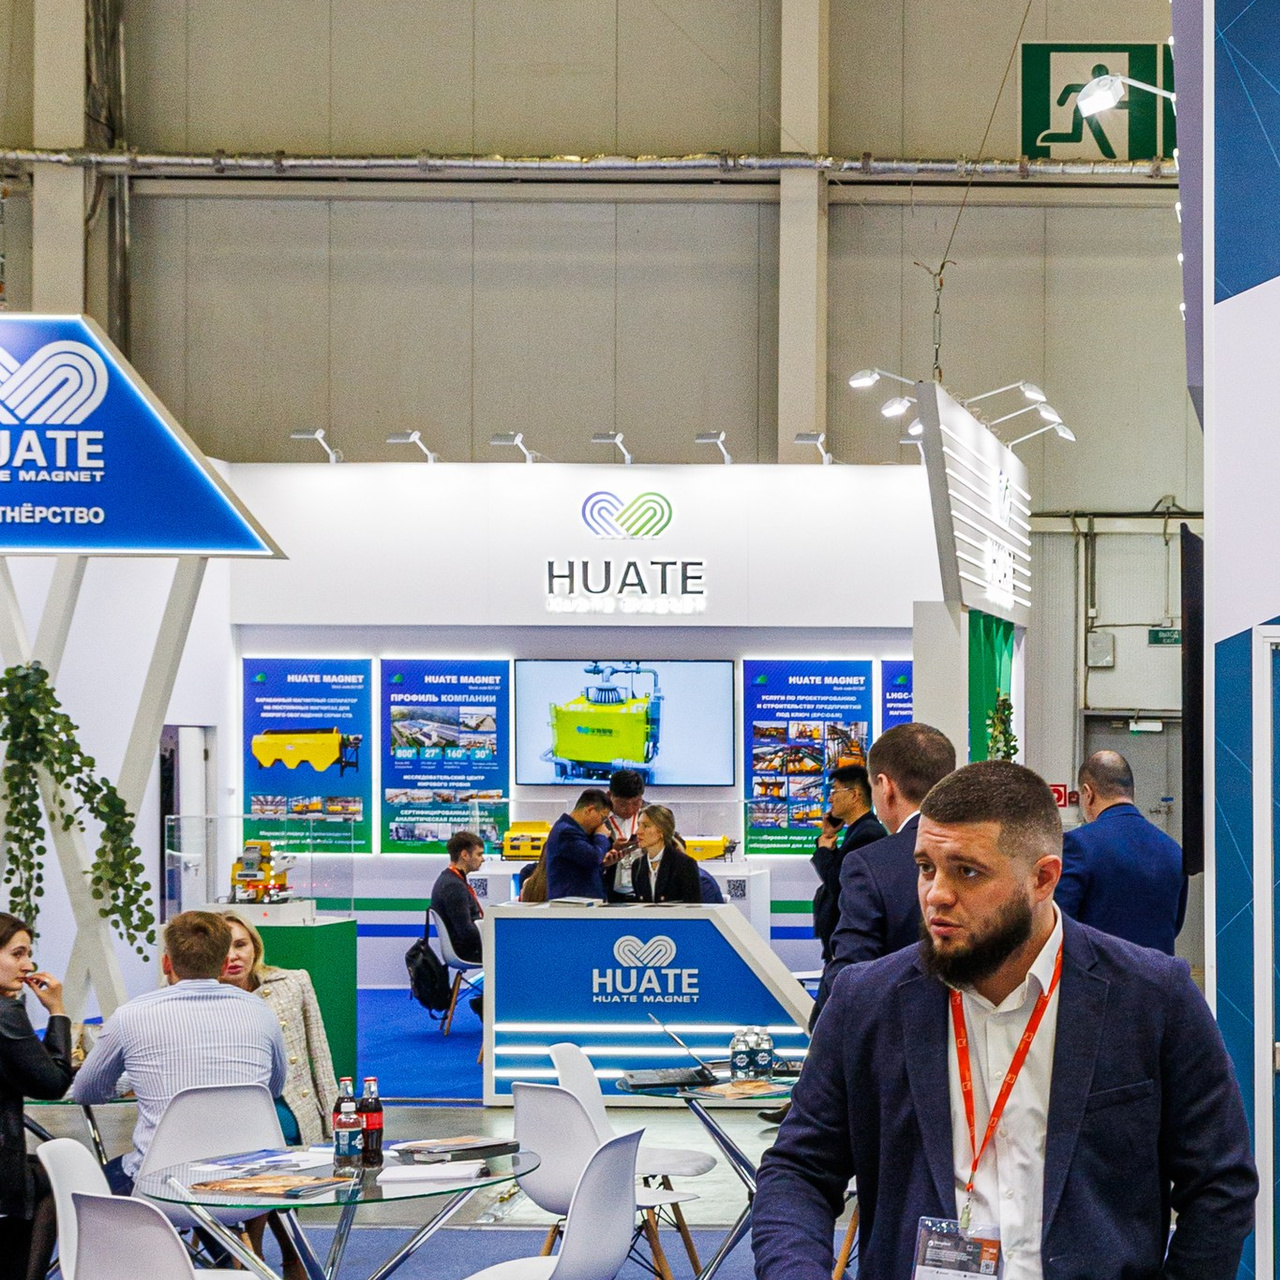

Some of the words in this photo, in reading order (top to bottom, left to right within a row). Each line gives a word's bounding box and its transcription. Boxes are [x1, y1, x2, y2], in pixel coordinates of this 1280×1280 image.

[18, 470, 105, 482] MAGNET
[546, 559, 705, 596] HUATE
[286, 674, 321, 684] HUATE
[322, 674, 365, 684] MAGNET
[424, 675, 459, 684] HUATE
[459, 675, 502, 685] MAGNET
[788, 676, 823, 685] HUATE
[823, 676, 866, 685] MAGNET
[390, 694, 440, 703] ПРОФИЛЬ
[440, 694, 497, 703] КОМПАНИИ
[592, 968, 700, 994] HUATE
[592, 995, 638, 1003] HUATE
[643, 995, 700, 1003] MAGNET
